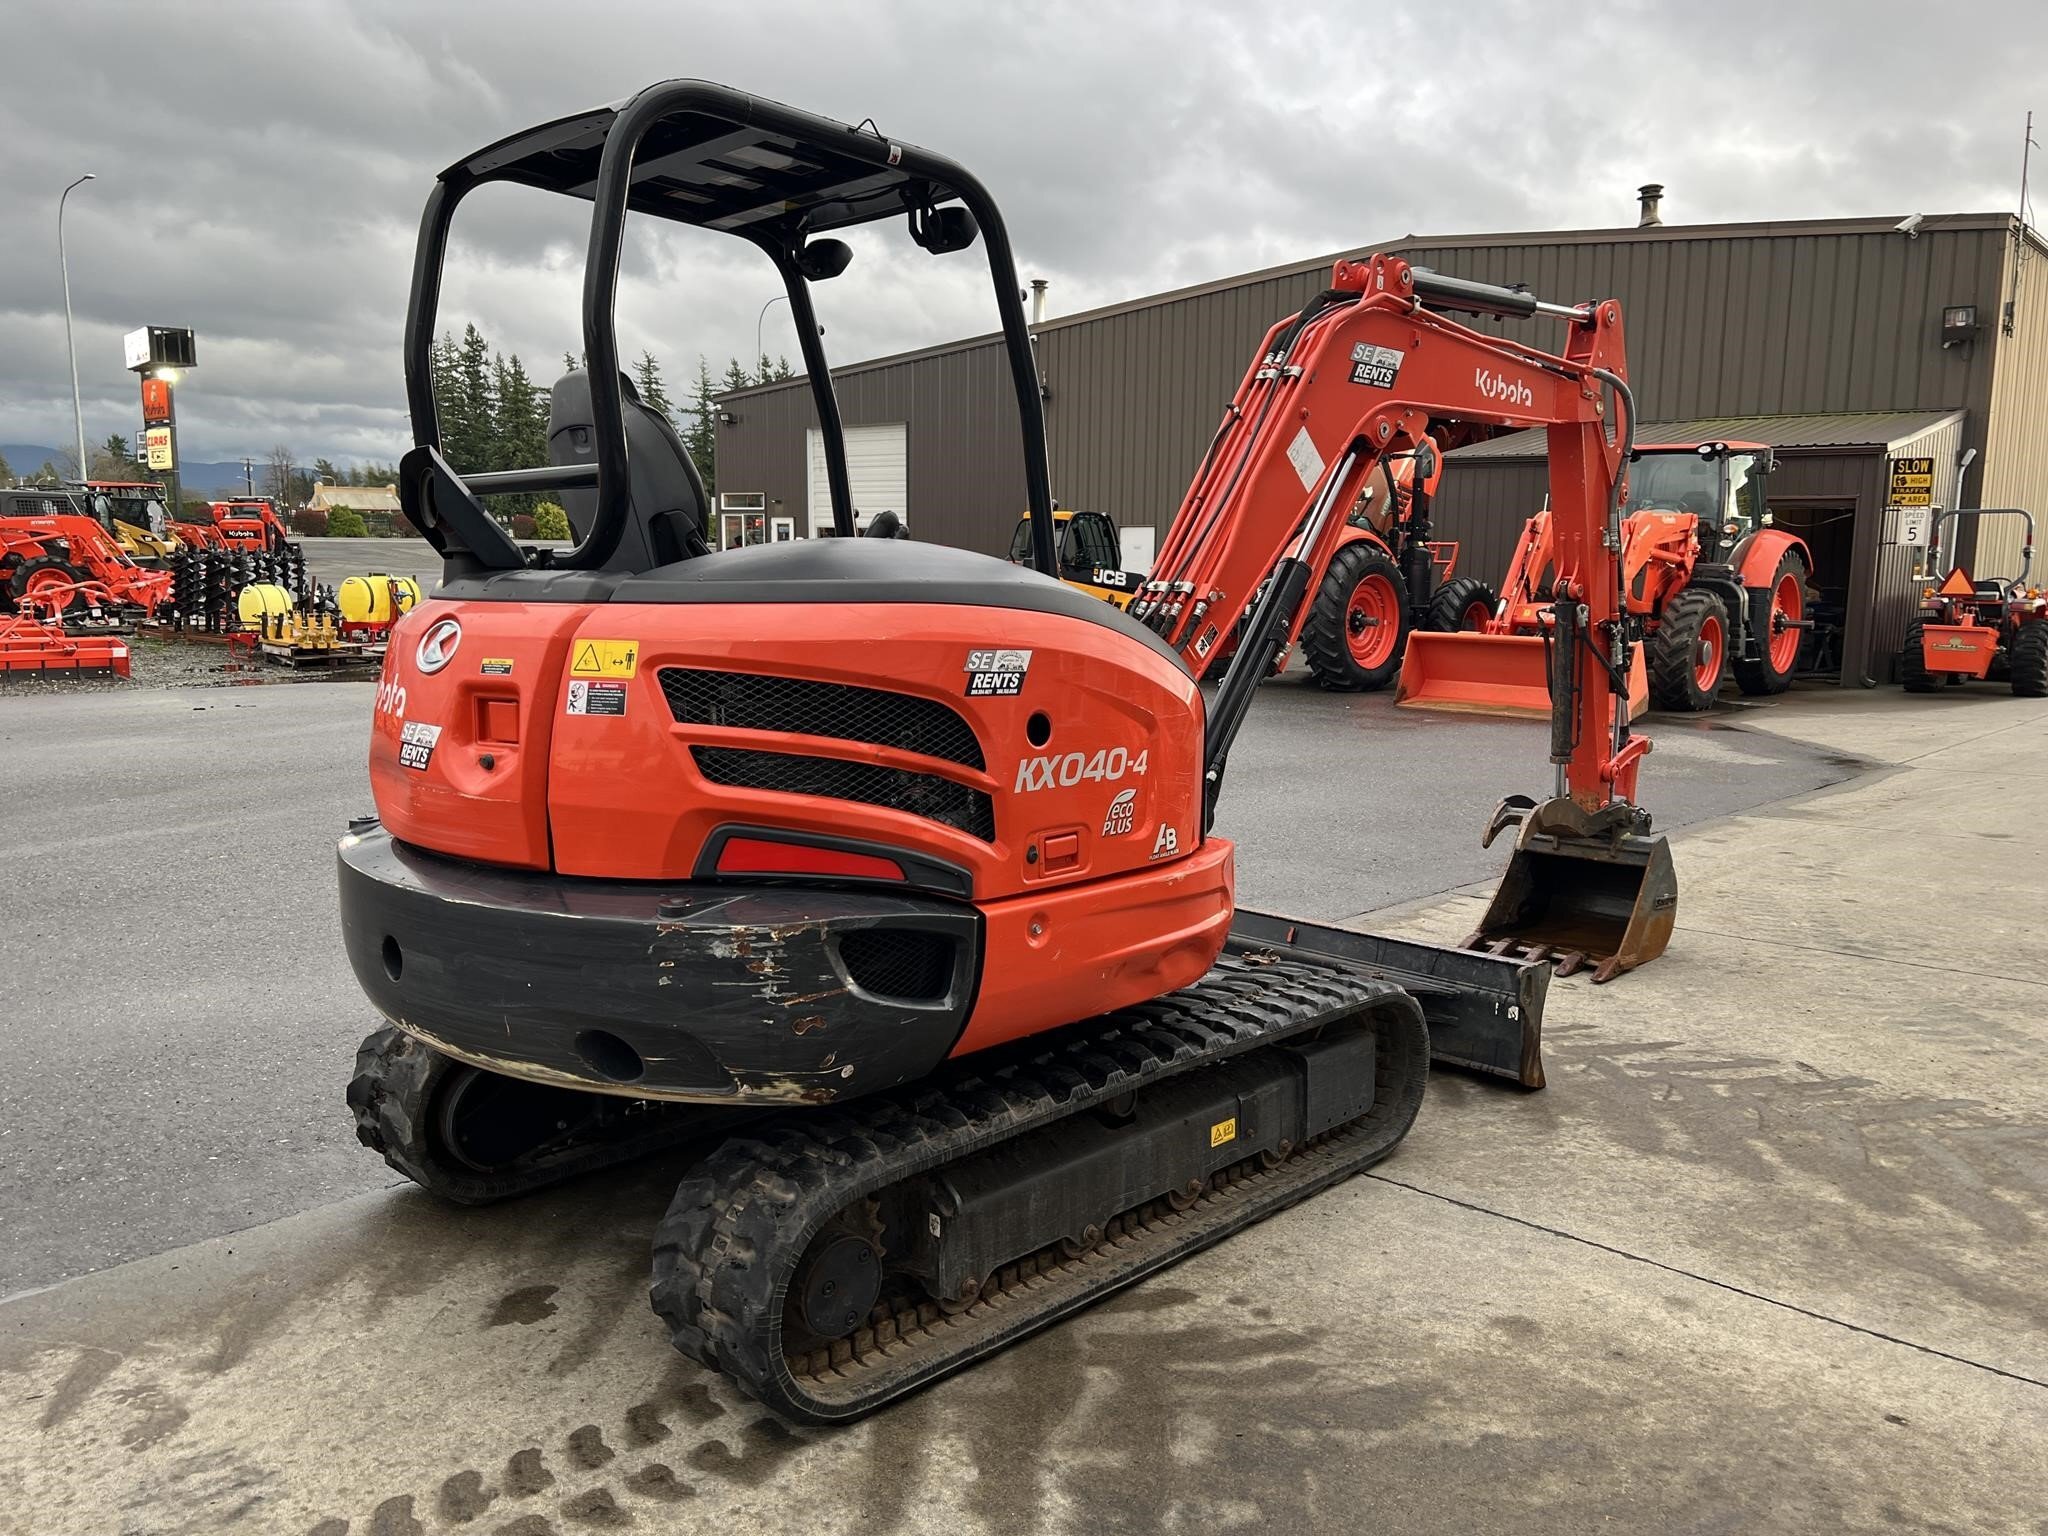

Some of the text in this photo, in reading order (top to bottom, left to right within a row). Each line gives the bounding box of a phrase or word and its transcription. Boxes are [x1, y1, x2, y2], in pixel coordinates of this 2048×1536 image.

[1354, 344, 1374, 361] SE
[1354, 363, 1393, 382] RENTS
[1475, 367, 1532, 407] Kubota
[147, 435, 168, 447] CLAAS
[1897, 460, 1929, 473] SLOW
[1910, 476, 1928, 485] HIGH
[1906, 495, 1927, 504] AREA
[228, 530, 255, 538] Kubota
[1907, 527, 1917, 541] 5
[1093, 568, 1127, 586] JCB
[967, 652, 993, 669] SE
[972, 672, 1020, 689] RENTS
[401, 723, 416, 741] SE
[401, 743, 430, 763] RENTS
[1014, 747, 1148, 793] KX040-4
[1111, 802, 1134, 819] eco
[1101, 817, 1133, 837] PLUS
